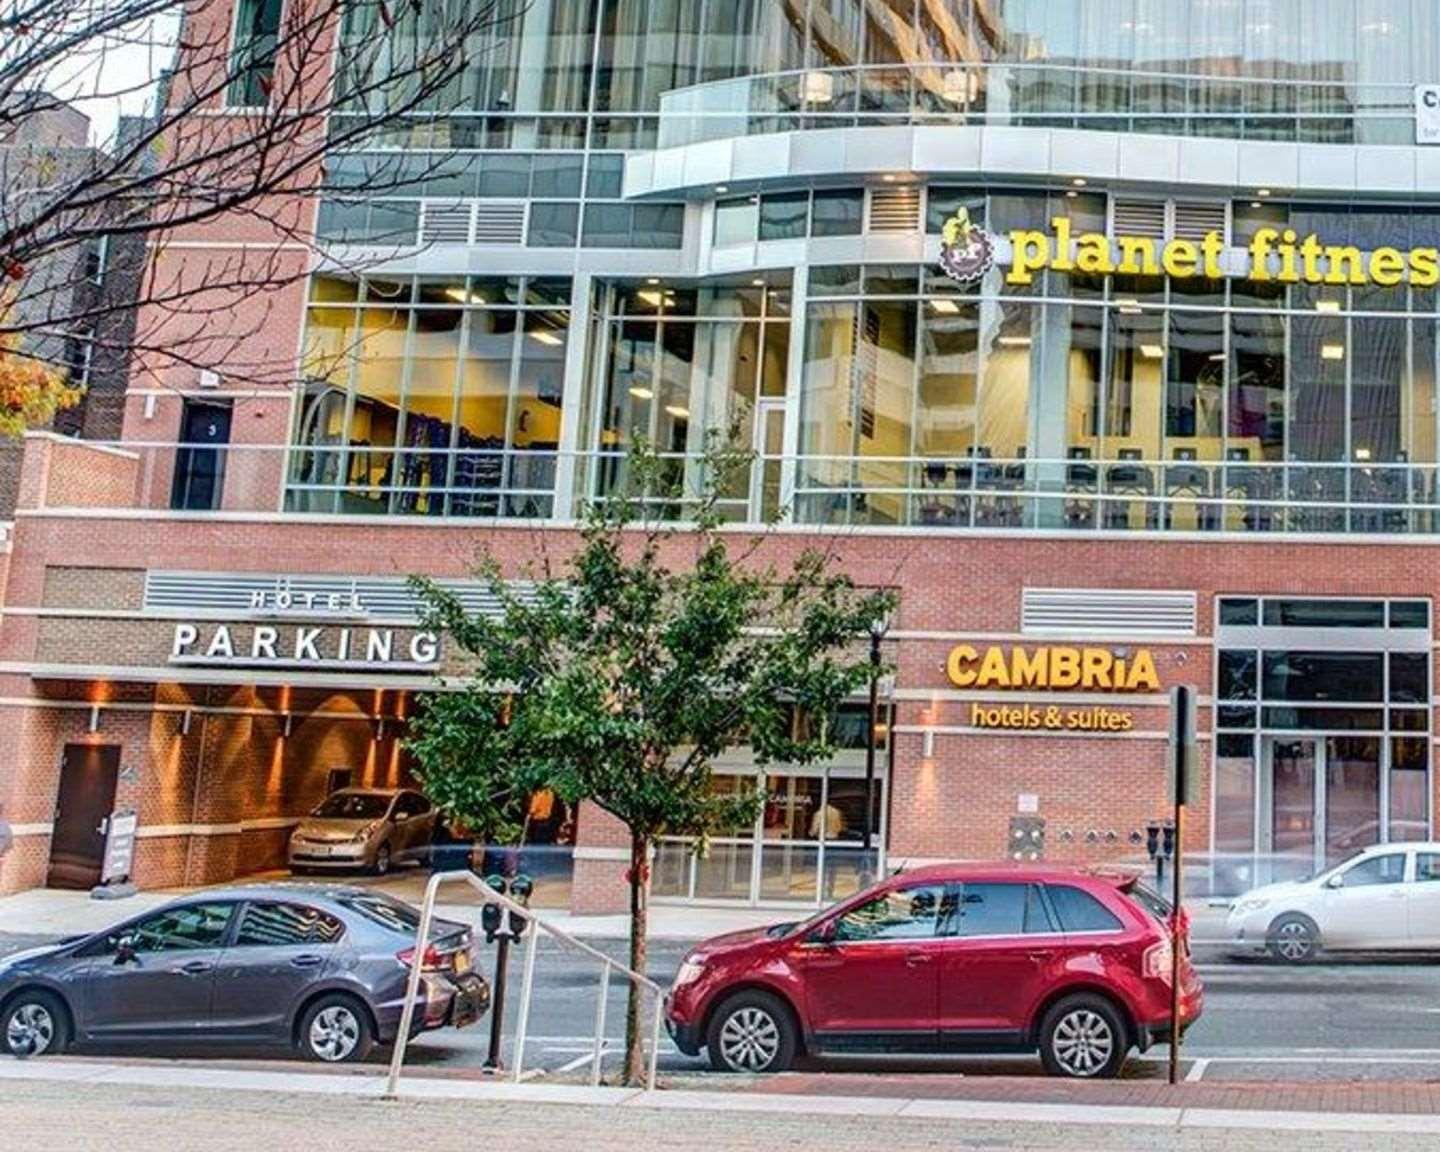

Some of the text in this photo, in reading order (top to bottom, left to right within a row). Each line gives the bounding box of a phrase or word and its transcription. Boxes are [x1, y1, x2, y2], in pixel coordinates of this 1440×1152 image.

[1006, 216, 1225, 284] planet
[249, 591, 366, 611] HOTEL
[172, 624, 439, 663] PARKING
[971, 703, 1133, 730] hotels & suites
